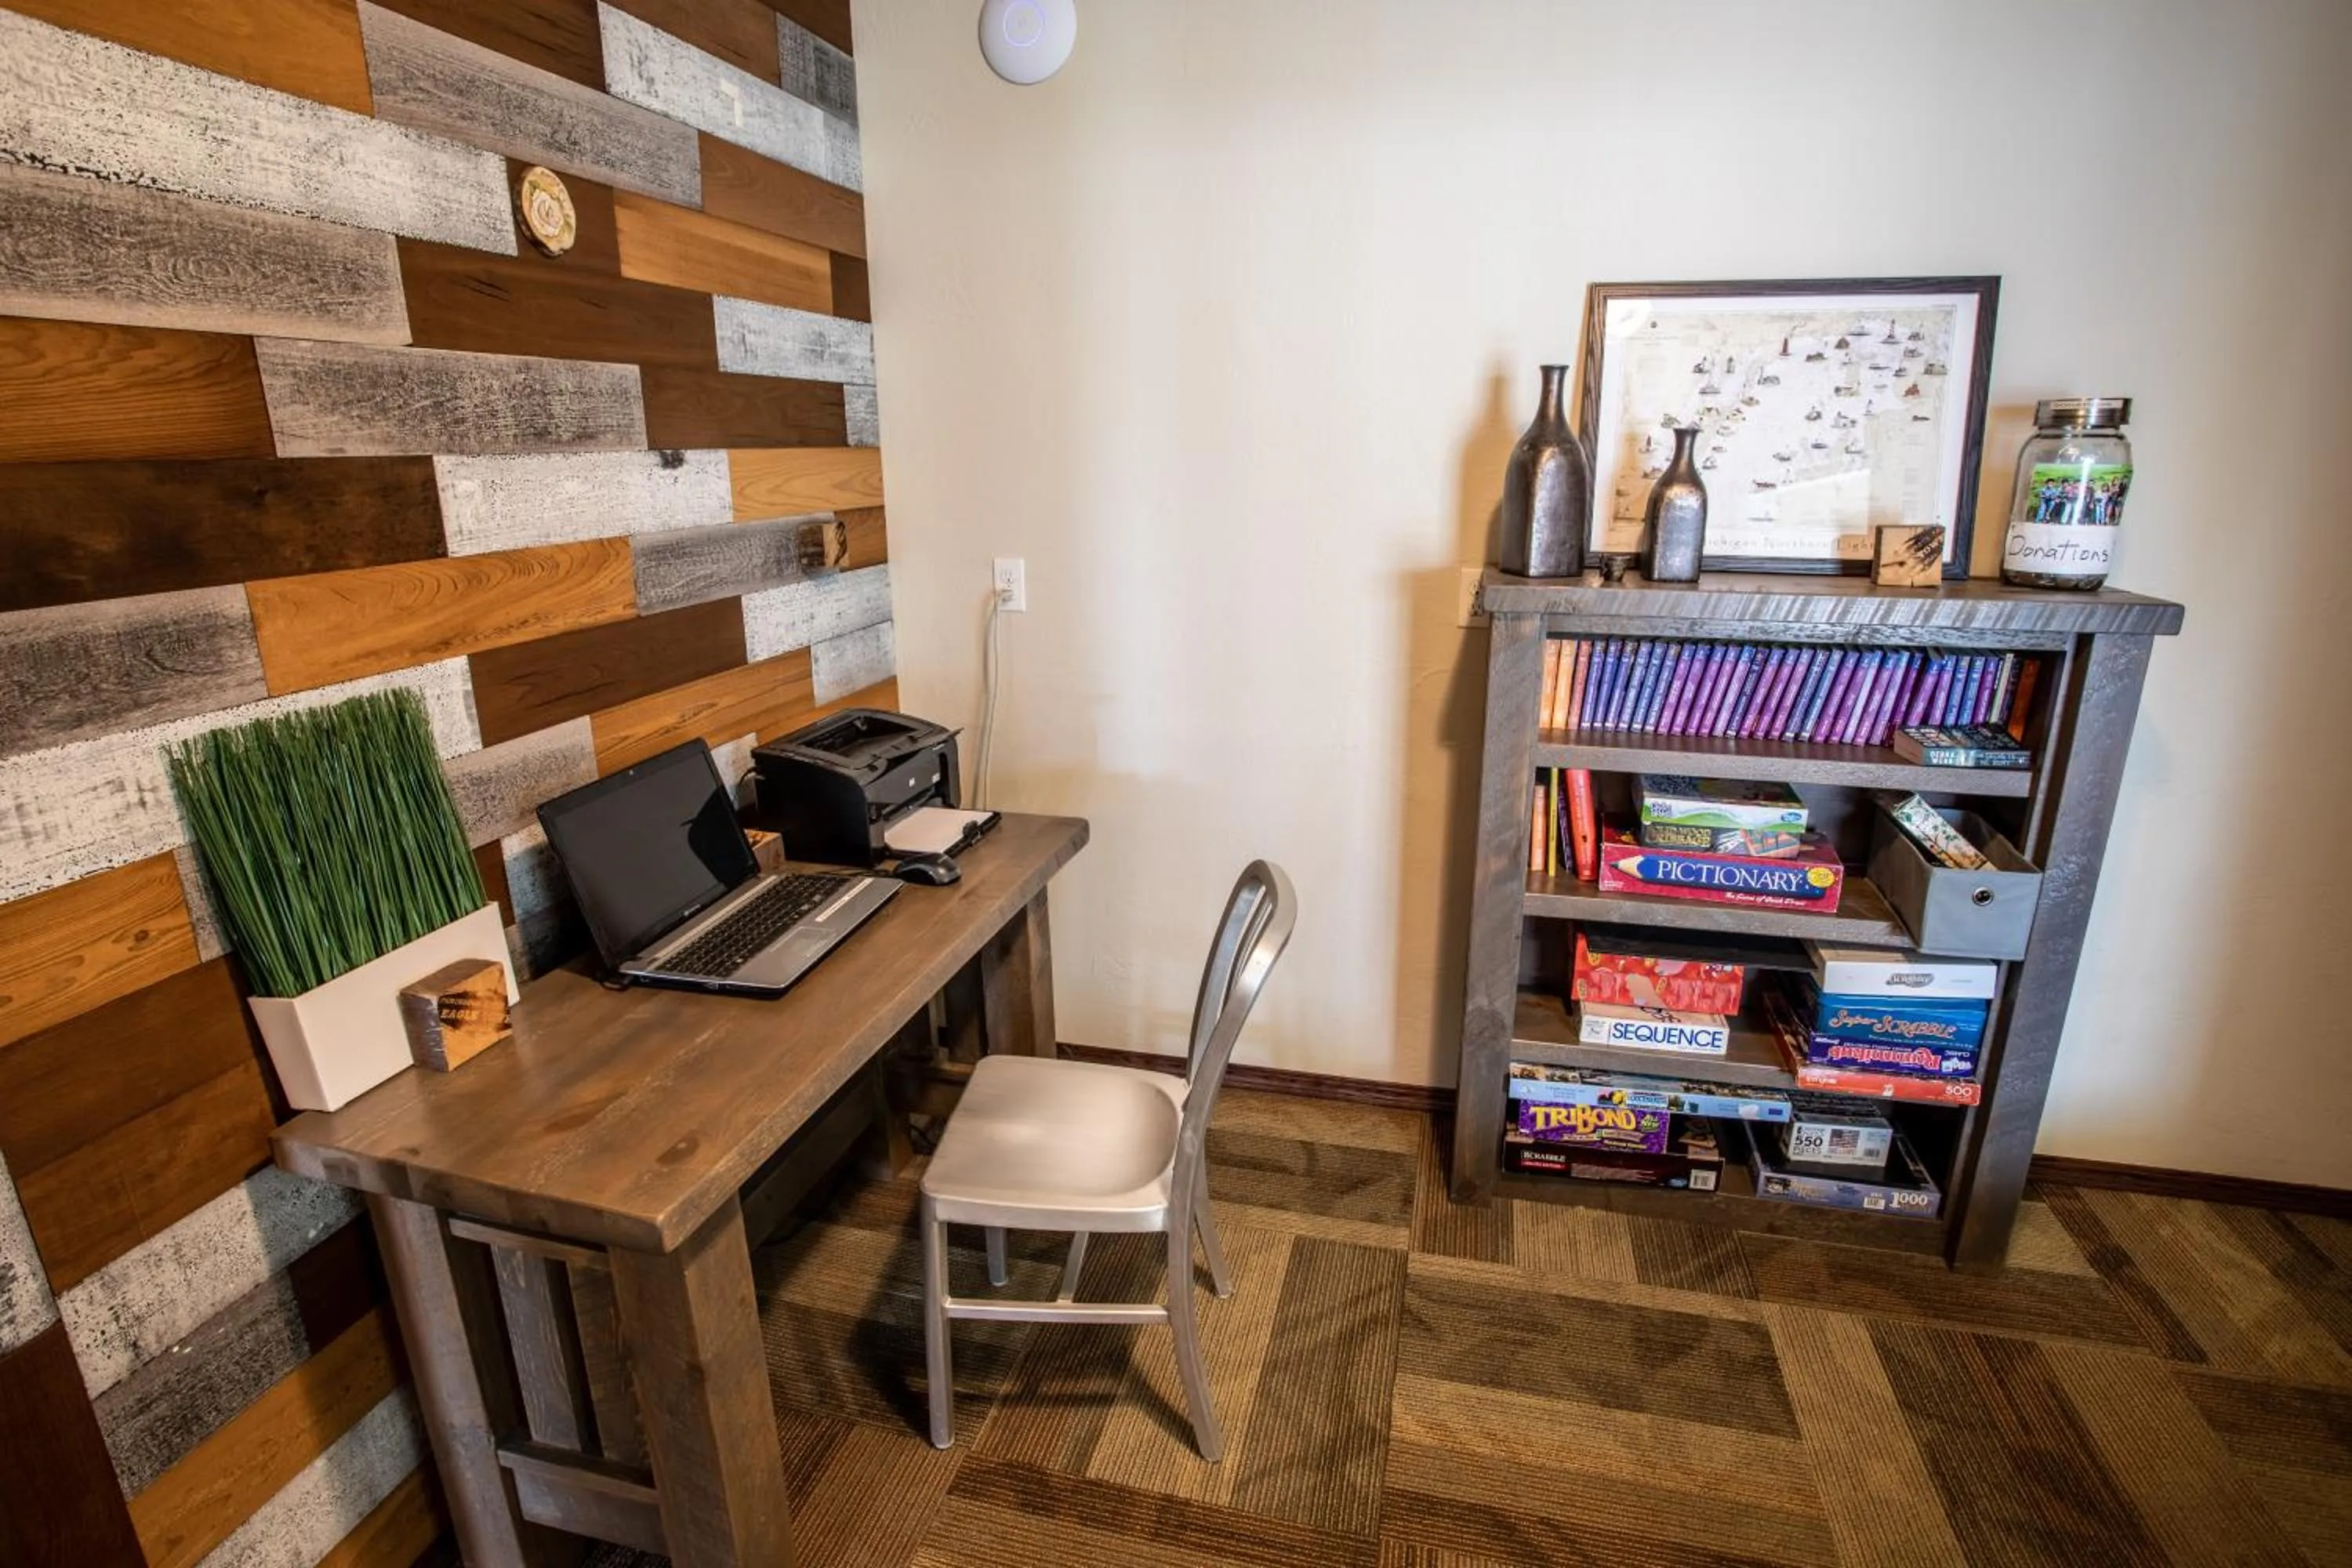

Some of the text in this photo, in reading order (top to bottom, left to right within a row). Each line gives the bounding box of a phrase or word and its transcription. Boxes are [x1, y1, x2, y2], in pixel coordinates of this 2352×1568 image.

[1705, 535, 1756, 550] ichigan
[1837, 538, 1875, 550] Light
[2008, 535, 2109, 562] Donations
[1657, 860, 1803, 891] PICTIONARY
[1612, 1022, 1723, 1048] SEQUENCE
[1944, 1084, 1973, 1097] 500
[1794, 1135, 1824, 1148] 550
[1889, 1191, 1929, 1208] 1000
